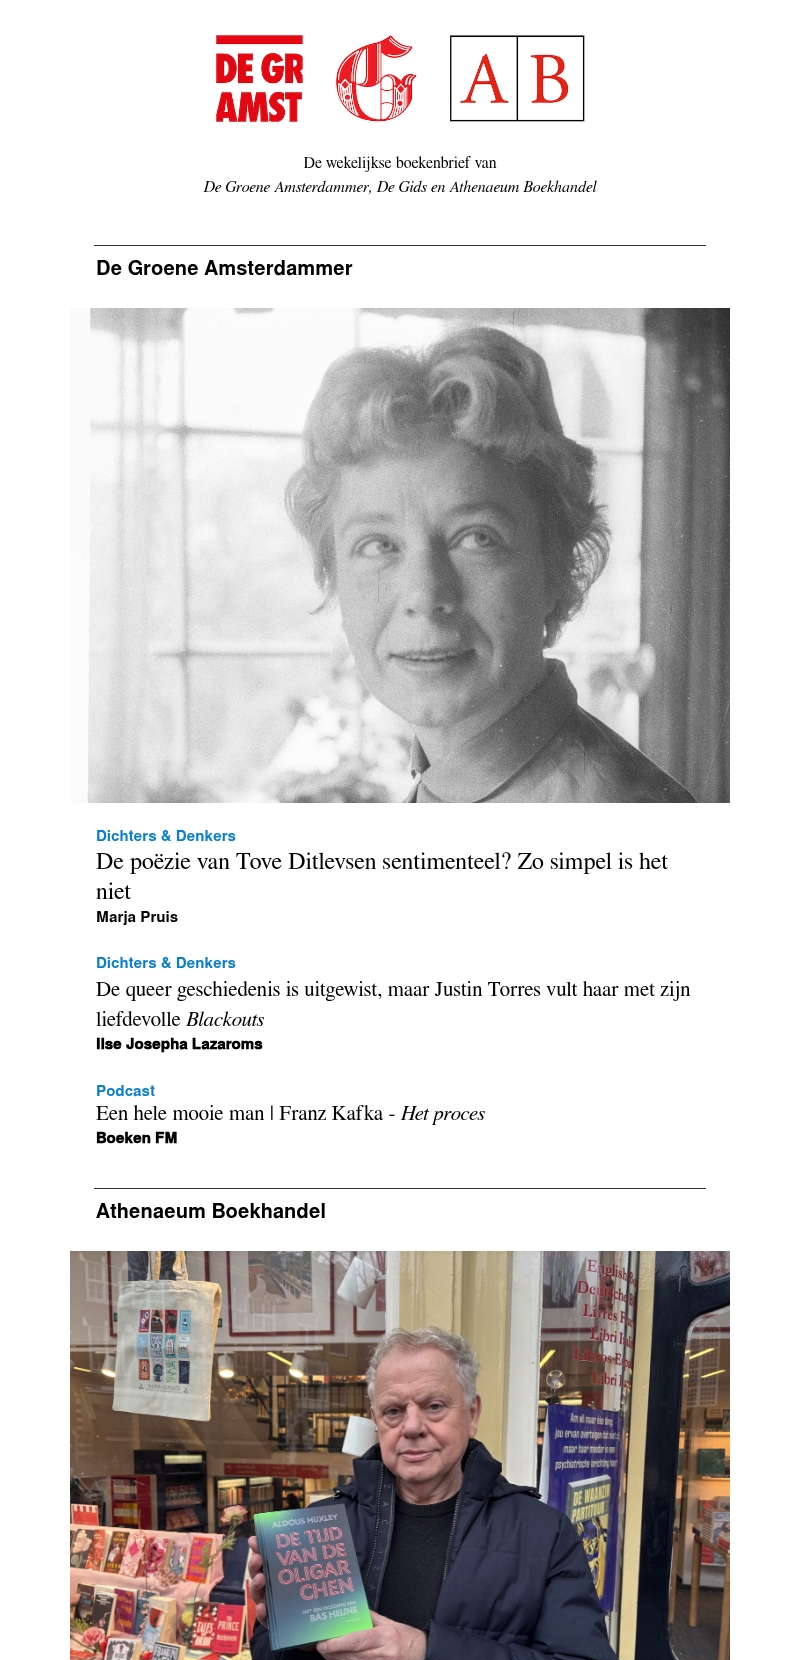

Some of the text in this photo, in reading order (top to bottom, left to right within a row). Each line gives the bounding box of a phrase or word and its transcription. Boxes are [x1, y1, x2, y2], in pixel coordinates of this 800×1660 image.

[216, 53, 303, 84] DE GR
[336, 35, 417, 121] G
[460, 54, 570, 104] A B
[216, 91, 303, 122] AMST
[304, 156, 496, 172] De wekelijkse boekenbrief van
[204, 181, 221, 192] De
[226, 181, 270, 192] Groene
[274, 181, 371, 194] Amsterdammer,
[377, 181, 395, 192] De
[399, 181, 427, 192] Gids
[449, 180, 519, 192] Athenaeum
[523, 180, 597, 192] Boekhandel
[97, 260, 352, 276] De Groene Amsterdammer
[97, 830, 236, 841] Dichters & Denkers
[96, 852, 668, 874] De poëzie van Tove Ditlevsen sentimenteel? Zo simpel is het
[96, 882, 131, 899] niet
[97, 911, 178, 925] Marja Pruis
[96, 1011, 264, 1026] liefdevolle Blackouts
[97, 1037, 263, 1052] Ilse Josepha Lazaroms
[97, 1085, 155, 1097] Podcast
[97, 1132, 177, 1143] Boeken FM
[96, 1203, 325, 1219] Athenaeum Boekhandel
[586, 1259, 628, 1280] English
[576, 1280, 627, 1303] Deutsche
[582, 1304, 618, 1321] Livres
[590, 1327, 617, 1343] Libri
[573, 1347, 612, 1364] Libros
[592, 1371, 617, 1386] Libri
[573, 1490, 582, 1507] DE
[272, 1514, 338, 1528] ALDOUS HUXLEY
[276, 1526, 343, 1548] DE TIJD
[276, 1542, 347, 1566] VAN DE
[278, 1560, 351, 1585] OLIGAR
[300, 1576, 354, 1601] CHEN
[309, 1612, 327, 1622] BAS
[196, 1621, 214, 1634] TALES
[218, 1620, 240, 1631] PRINCE
